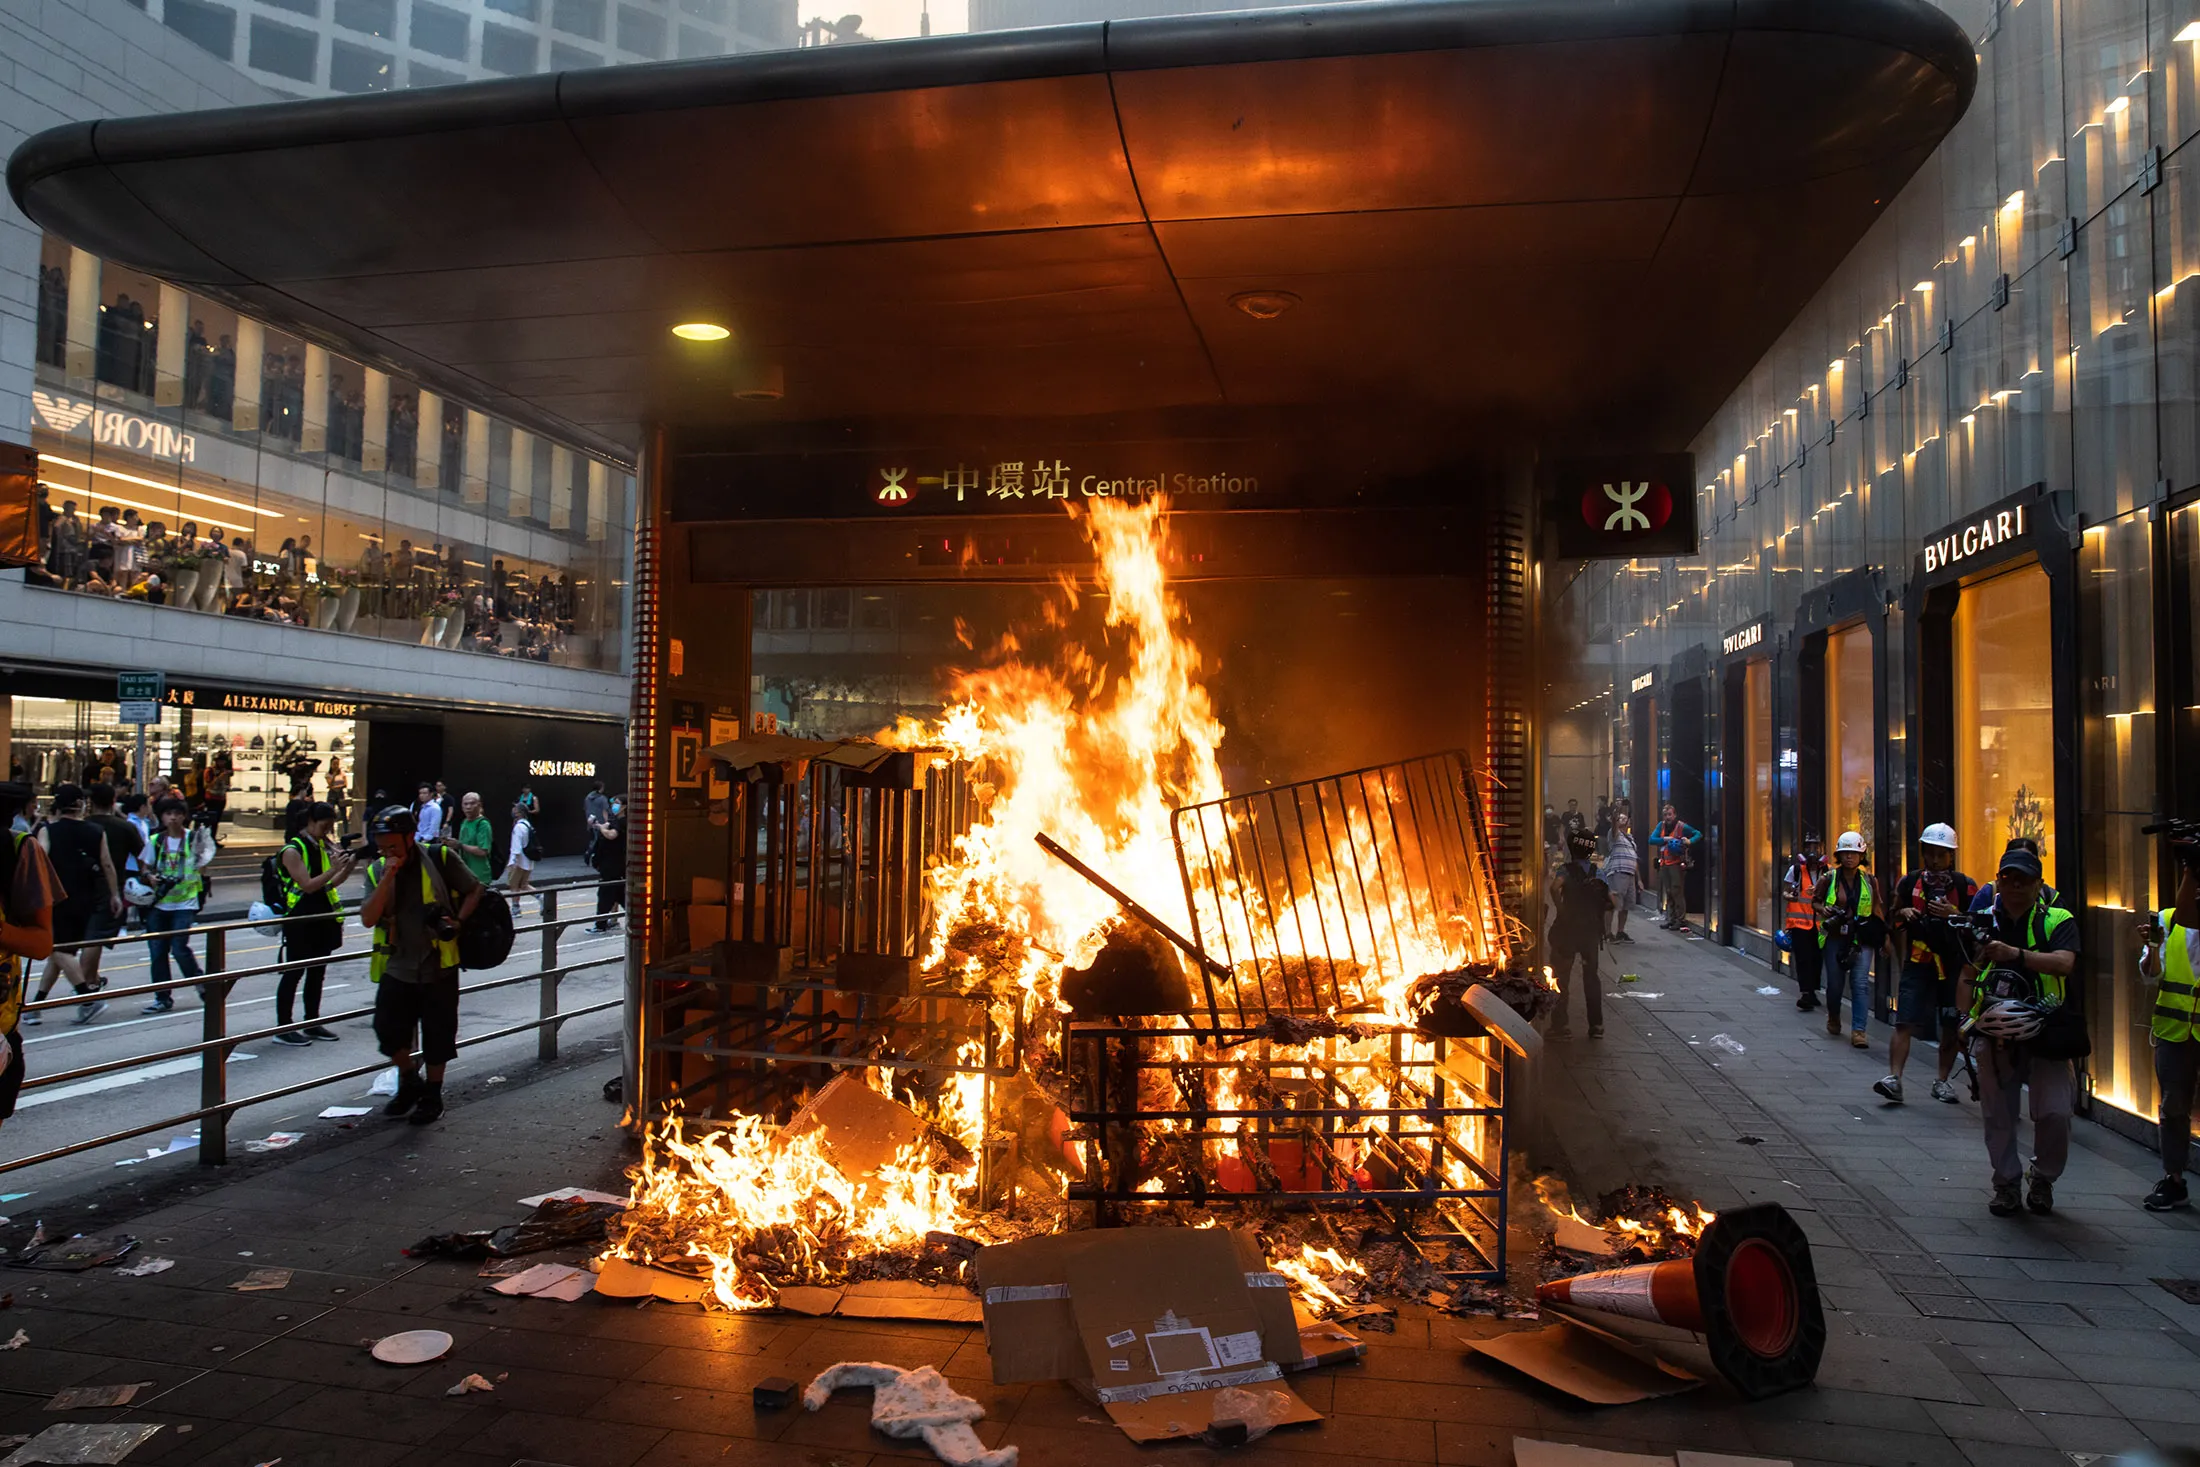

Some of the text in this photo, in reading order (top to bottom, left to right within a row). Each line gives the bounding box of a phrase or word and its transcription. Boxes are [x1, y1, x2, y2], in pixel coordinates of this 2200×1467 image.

[943, 459, 1071, 501] 中環站
[1080, 471, 1258, 497] Central Station
[1924, 504, 2023, 574] BVLGARI
[1723, 623, 1762, 655] BVLGARI
[223, 693, 357, 716] ALEXANDRA HOUSE
[236, 753, 264, 761] SAINT
